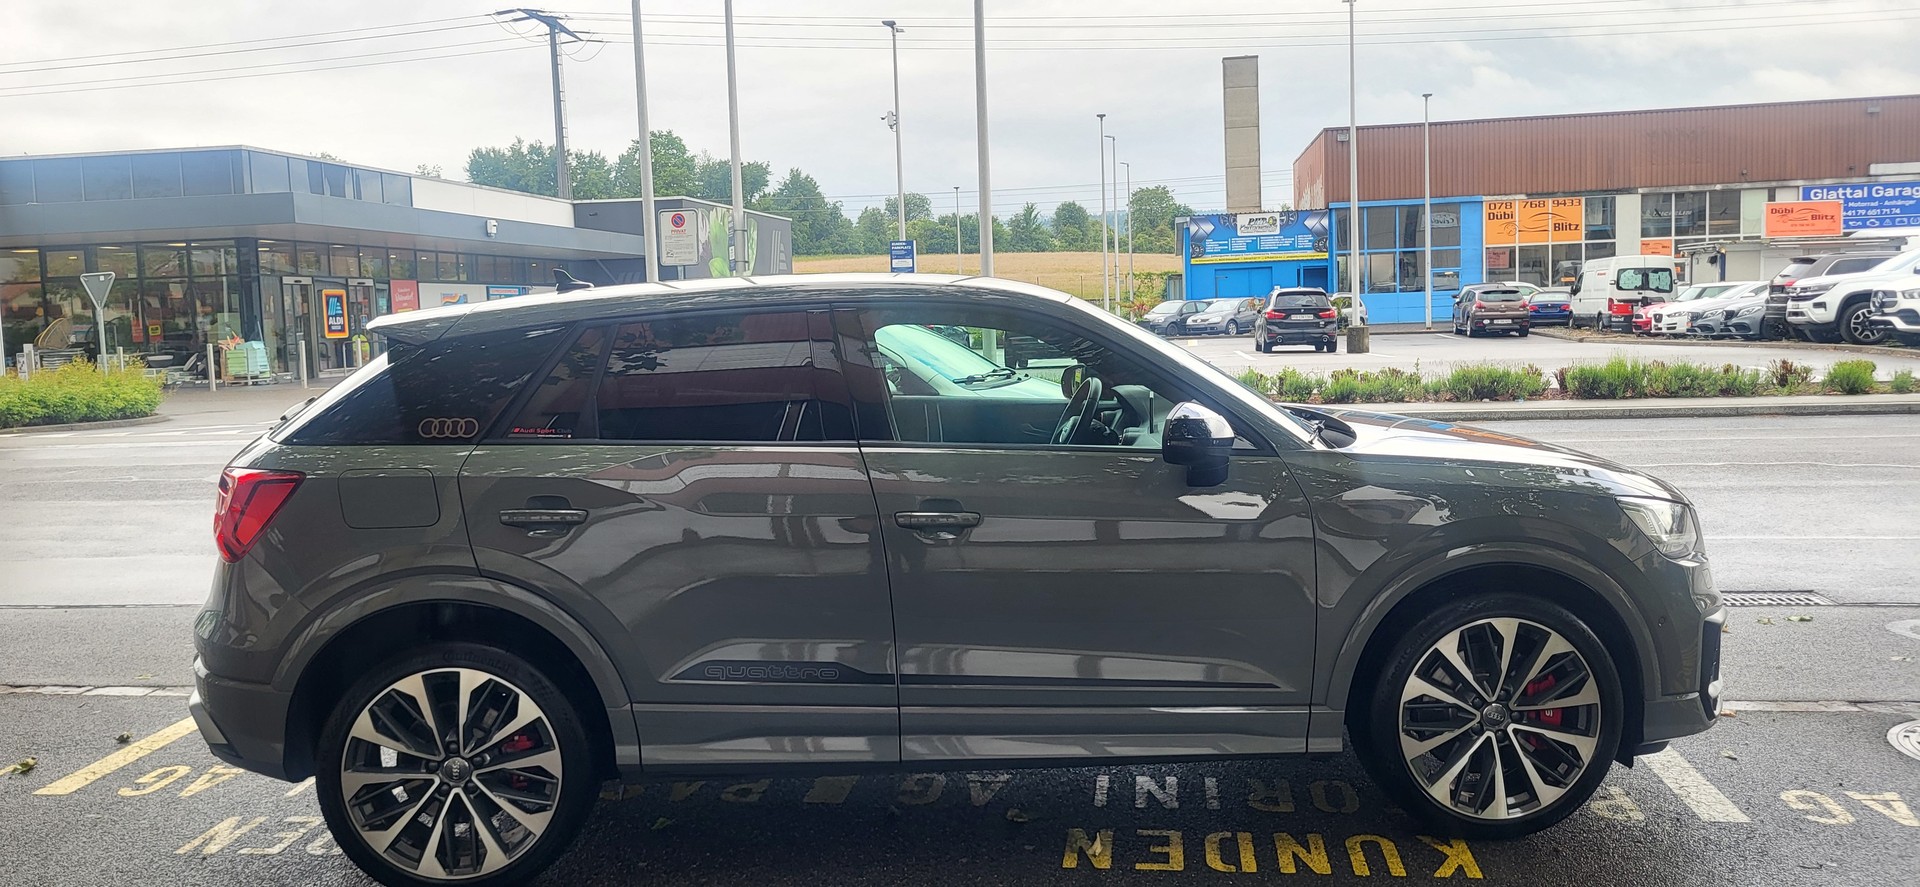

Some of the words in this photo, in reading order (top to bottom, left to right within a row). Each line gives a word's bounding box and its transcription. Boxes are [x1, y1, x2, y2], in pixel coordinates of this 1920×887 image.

[1810, 187, 1868, 200] Glattal
[1489, 202, 1513, 211] 078
[1522, 200, 1546, 209] 768
[1552, 198, 1582, 207] 9433
[1488, 211, 1514, 221] Dübi
[1770, 207, 1795, 215] Dübi
[1553, 222, 1581, 232] Blitz
[328, 316, 344, 326] ALDI
[536, 427, 556, 435] Sport
[704, 665, 840, 680] quattro
[1062, 828, 1485, 879] KUNDEN
